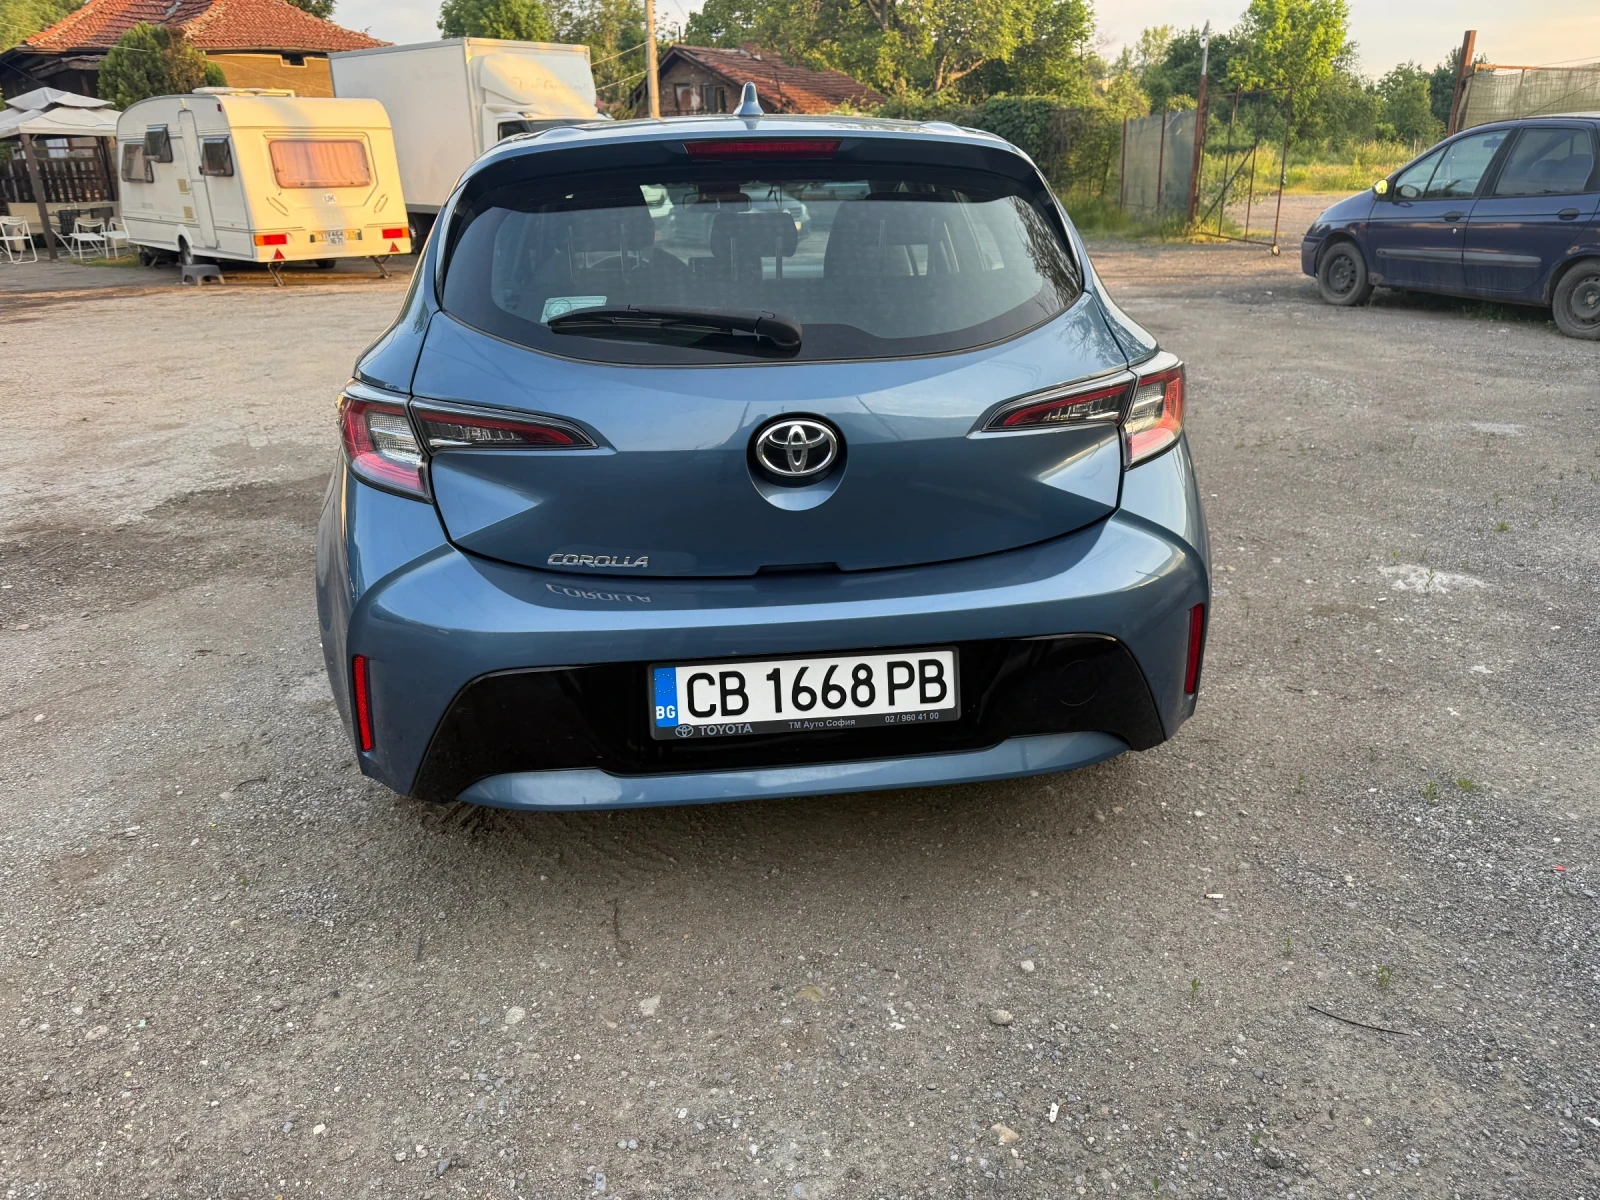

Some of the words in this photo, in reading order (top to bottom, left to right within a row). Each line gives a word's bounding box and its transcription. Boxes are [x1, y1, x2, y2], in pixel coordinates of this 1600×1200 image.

[324, 194, 336, 203] UK
[547, 553, 649, 568] COROLLA
[686, 670, 750, 718] CB
[766, 663, 876, 714] 1668
[886, 658, 948, 707] PB
[655, 705, 676, 720] BG
[884, 715, 896, 723] 02
[901, 714, 916, 722] 960
[917, 713, 928, 721] 41
[929, 711, 940, 720] 00
[698, 723, 753, 736] TOYOTA
[803, 720, 825, 730] Ауто
[826, 718, 856, 729] София
